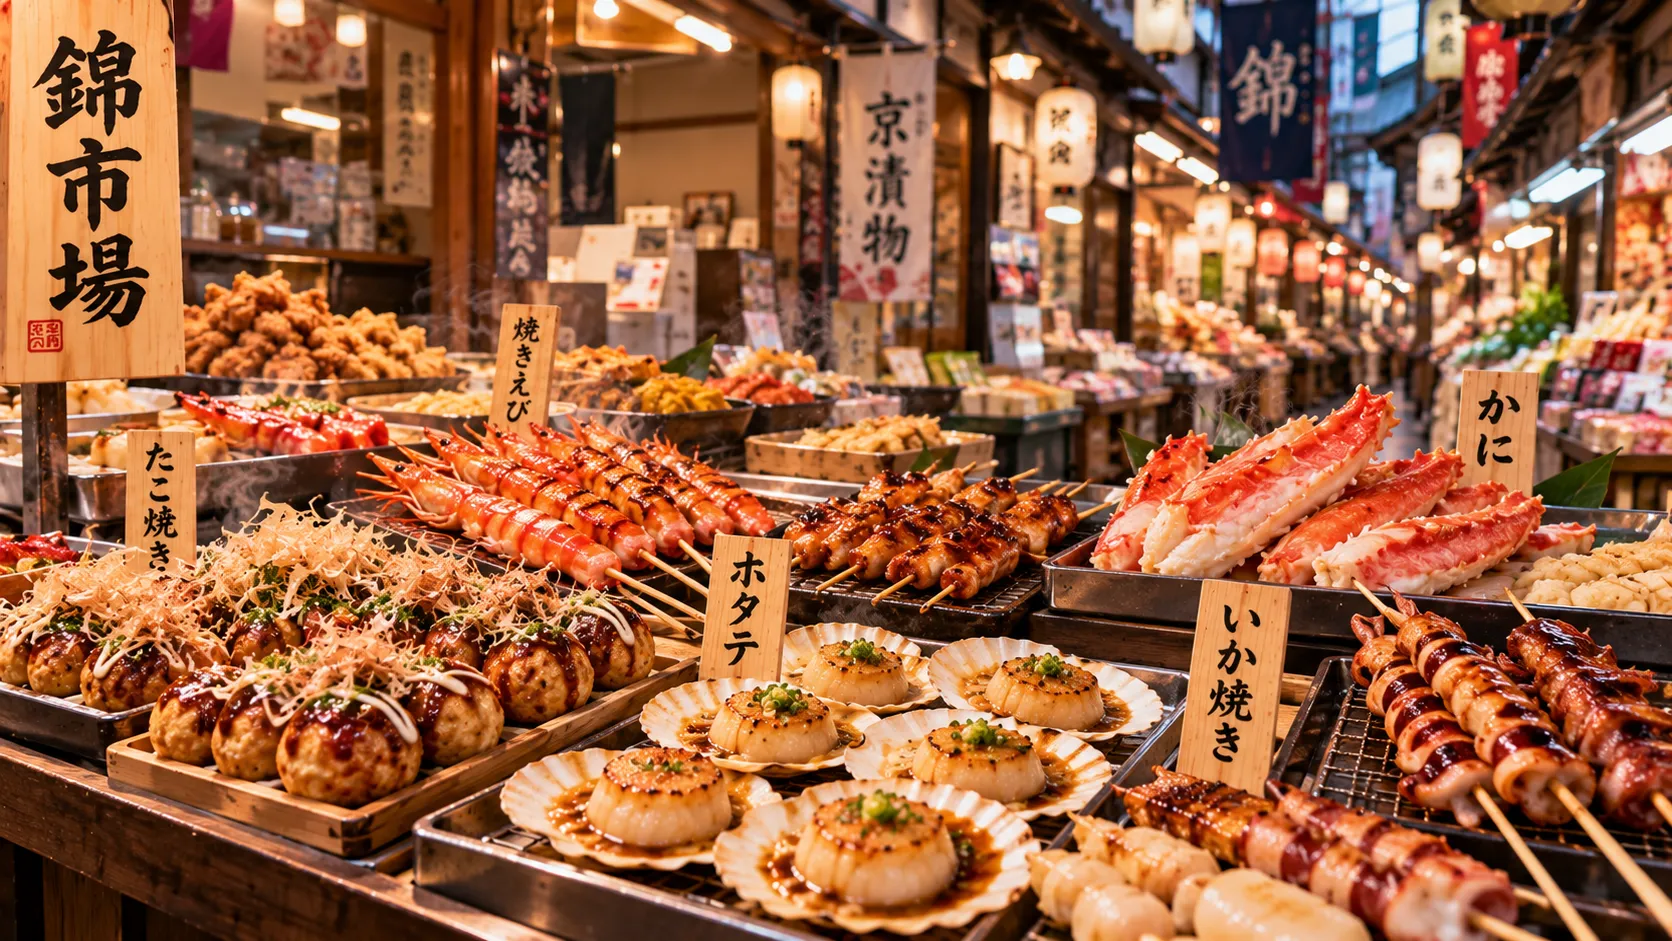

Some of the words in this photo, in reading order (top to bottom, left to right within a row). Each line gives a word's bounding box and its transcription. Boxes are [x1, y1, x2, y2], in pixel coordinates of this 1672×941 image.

[1228, 40, 1300, 136] 錦
[33, 29, 150, 328] 錦市場
[863, 91, 911, 265] 京漬物
[507, 316, 540, 422] 焼きえび
[1477, 389, 1520, 467] かに
[143, 442, 178, 571] たこ焼き
[724, 551, 766, 666] ホタテ
[1207, 604, 1261, 763] いか焼き
